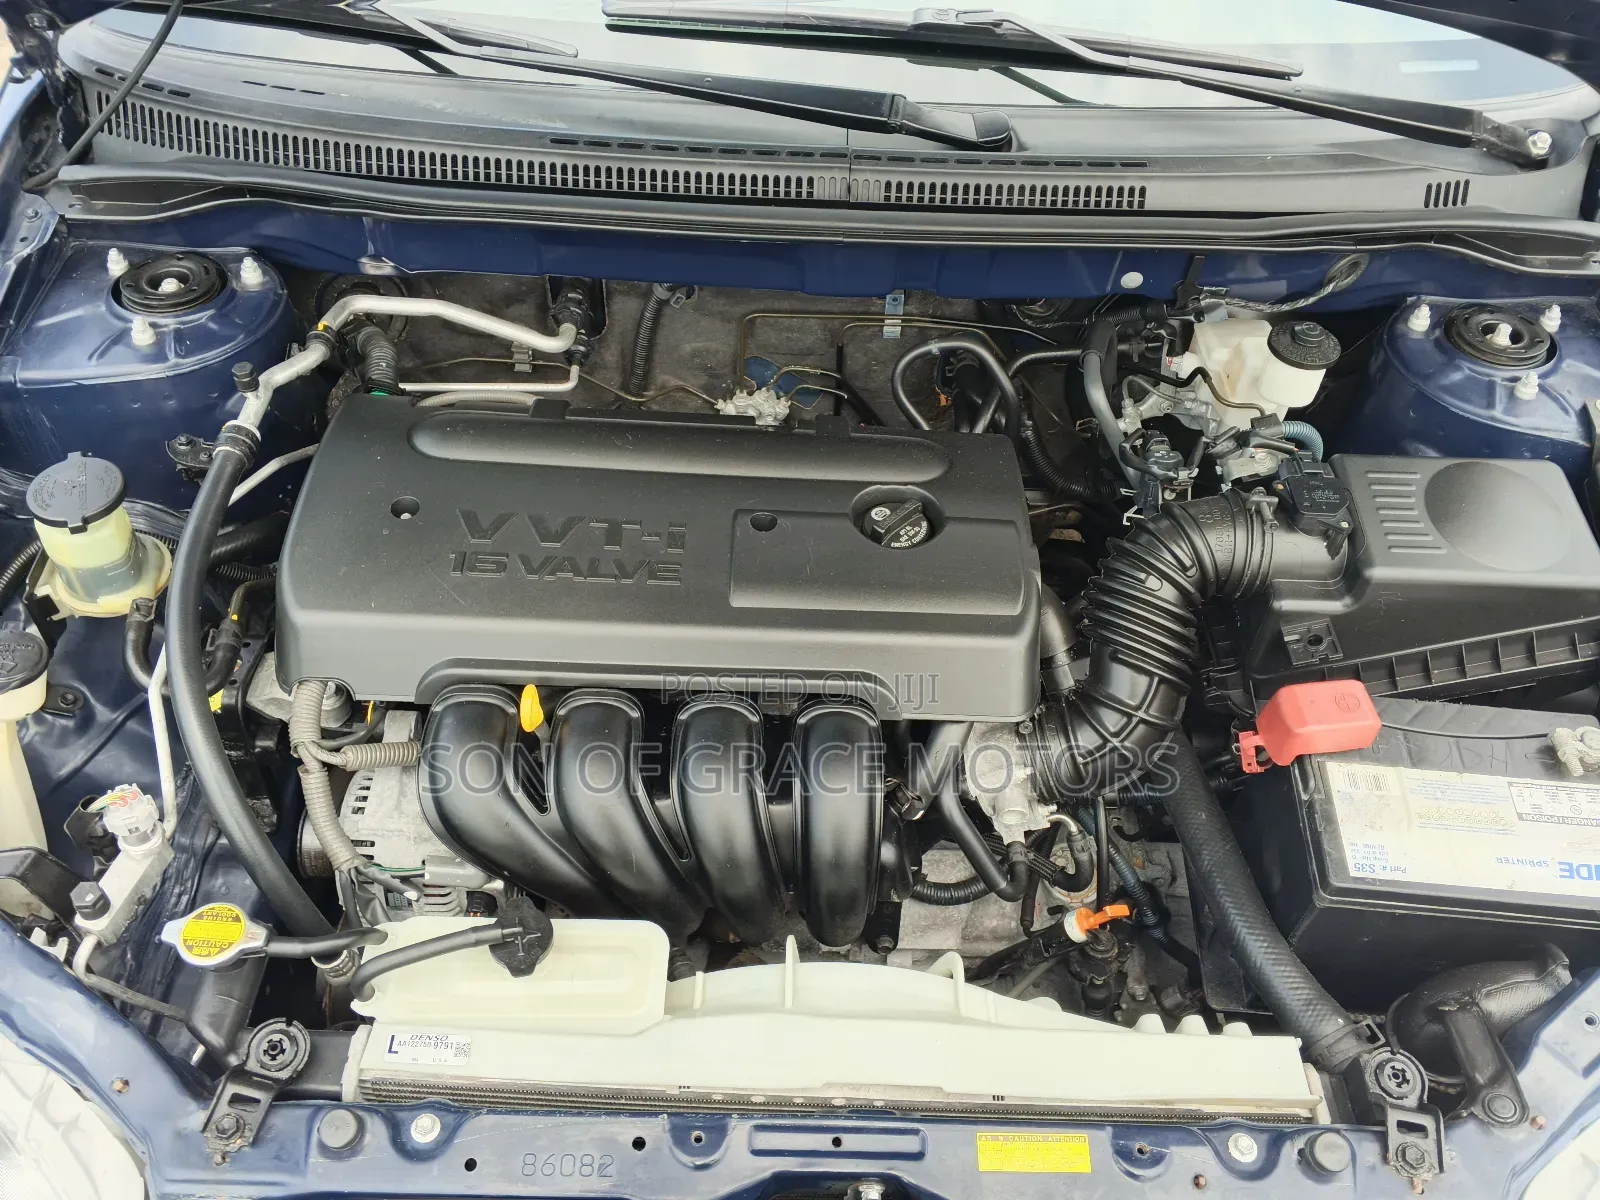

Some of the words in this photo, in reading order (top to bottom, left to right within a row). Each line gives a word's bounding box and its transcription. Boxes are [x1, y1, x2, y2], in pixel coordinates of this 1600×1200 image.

[449, 550, 510, 577] 16
[516, 553, 683, 586] VALVE
[1522, 813, 1559, 823] POISON
[1353, 862, 1376, 874] S35
[1495, 856, 1550, 868] SPRINTER
[1389, 865, 1407, 874] Part
[186, 939, 229, 949] CAUTION
[409, 1034, 449, 1042] DENSO
[387, 1034, 399, 1055] L
[521, 1152, 615, 1178] 86082
